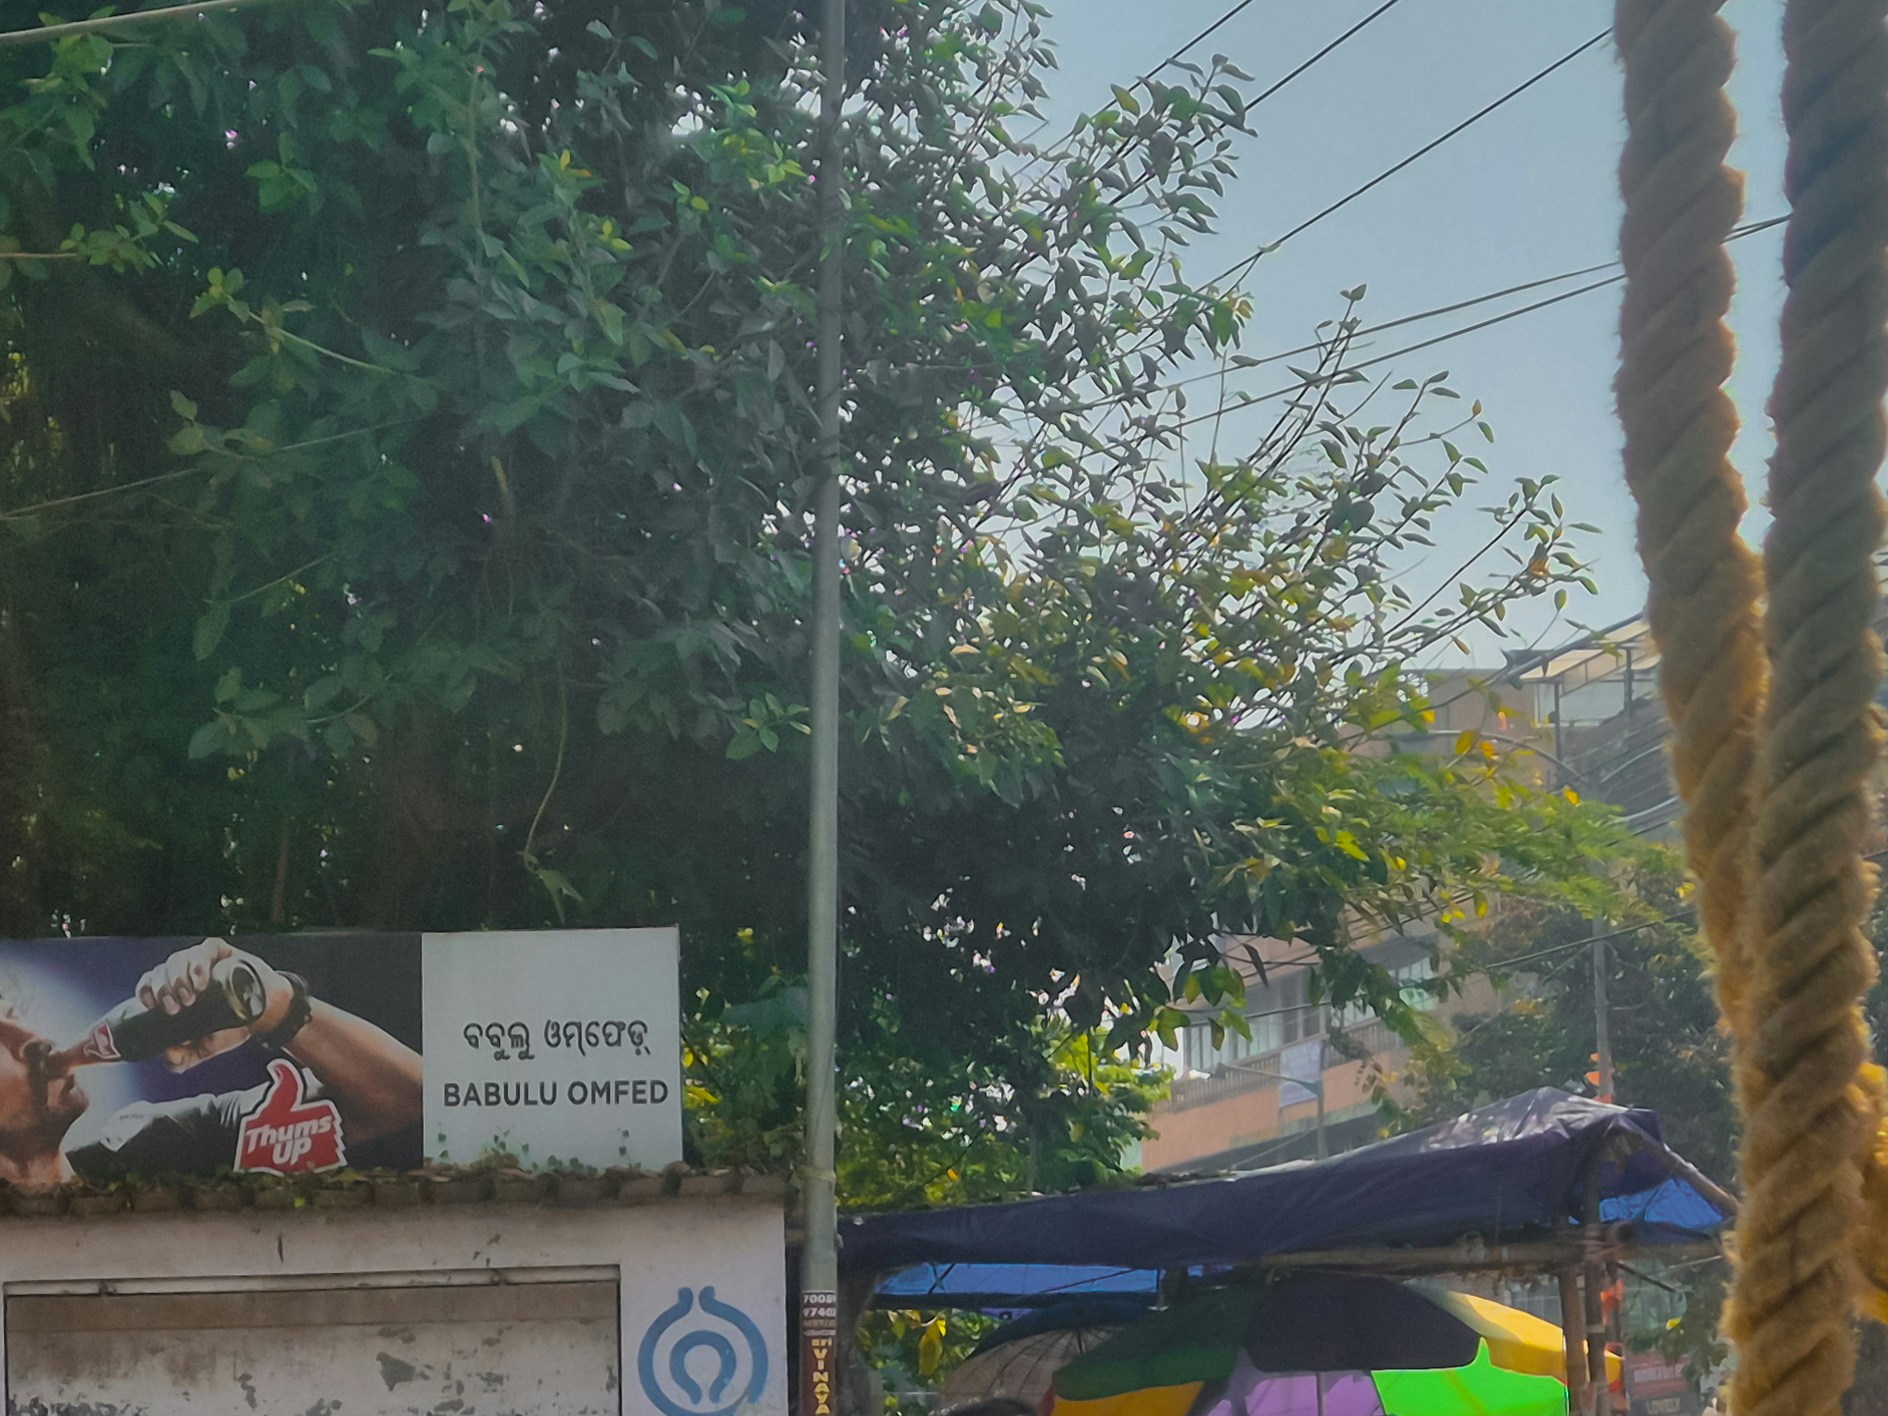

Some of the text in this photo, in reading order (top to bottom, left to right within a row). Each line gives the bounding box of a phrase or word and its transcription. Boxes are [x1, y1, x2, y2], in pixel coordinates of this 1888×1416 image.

[443, 1079, 669, 1107] BABULU OMFED
[245, 1115, 333, 1154] Thums
